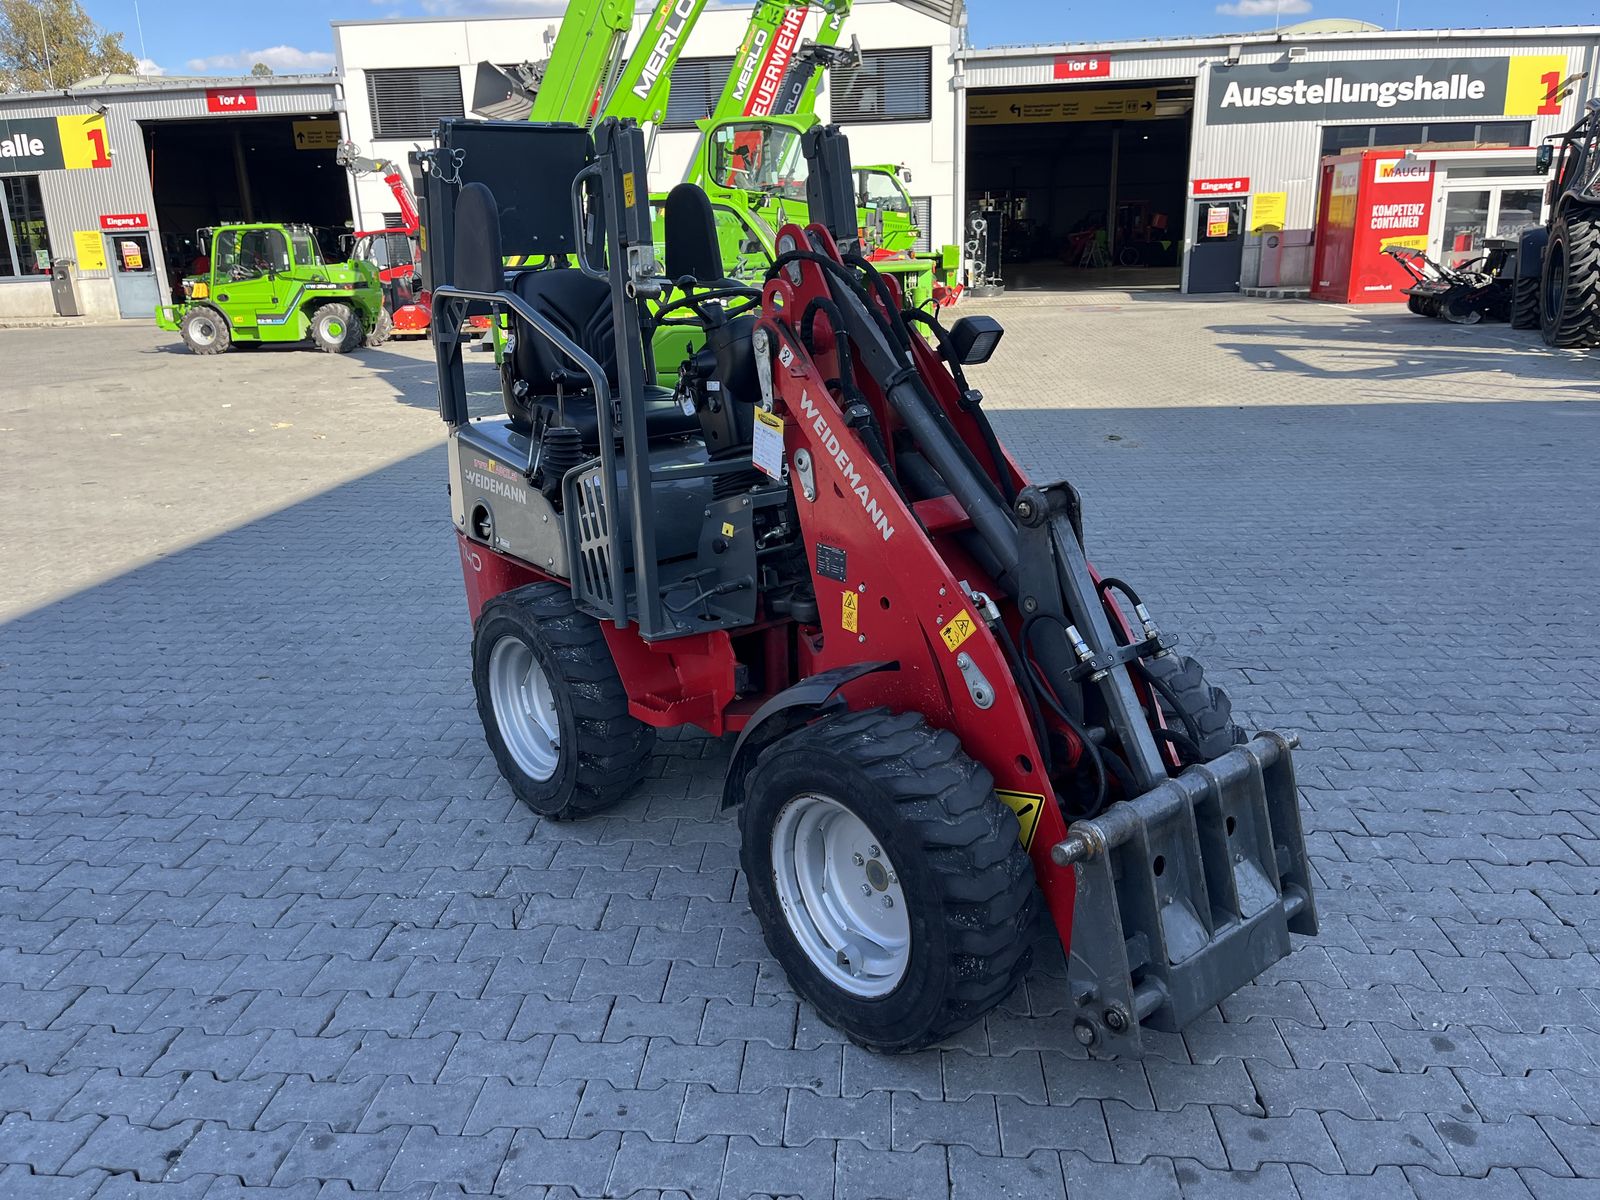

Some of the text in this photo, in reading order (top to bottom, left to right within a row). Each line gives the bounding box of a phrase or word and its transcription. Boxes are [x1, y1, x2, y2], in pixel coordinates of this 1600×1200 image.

[632, 0, 697, 99] MERLO
[732, 29, 769, 101] MERLO
[749, 8, 803, 117] EUERWEHR
[1067, 59, 1098, 71] Tor B
[217, 94, 247, 106] Tor A
[783, 82, 803, 115] RLO
[1220, 71, 1562, 115] Ausstellungshalle 1
[0, 128, 112, 168] alle 1
[1200, 180, 1242, 191] Eingang B
[1383, 166, 1427, 178] MAUCH
[106, 216, 142, 226] Eingang A
[1370, 216, 1420, 229] CONTAINER
[1372, 203, 1425, 217] KOMPETENZ
[799, 387, 895, 542] WEIDEMANN
[465, 469, 528, 505] WEIDEMANN
